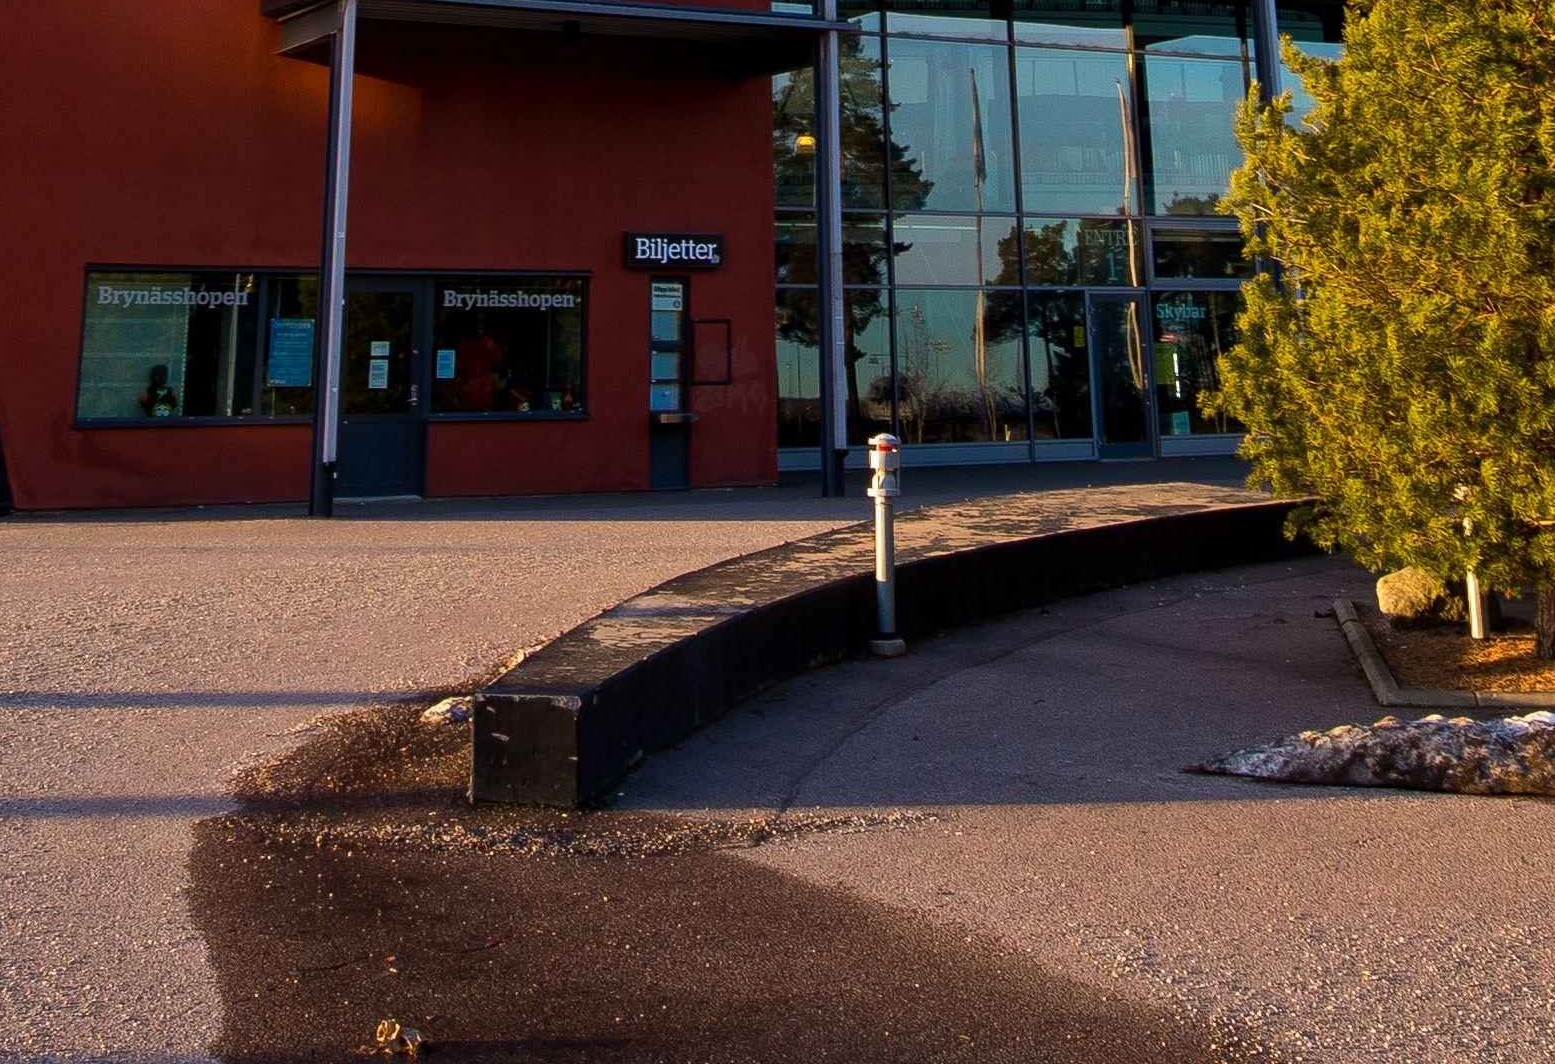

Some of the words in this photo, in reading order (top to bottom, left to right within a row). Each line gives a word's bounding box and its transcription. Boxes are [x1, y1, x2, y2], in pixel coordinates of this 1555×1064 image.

[97, 286, 249, 309] Brynässhopen
[443, 290, 576, 311] Brynässhopen
[1156, 303, 1207, 322] Skybar
